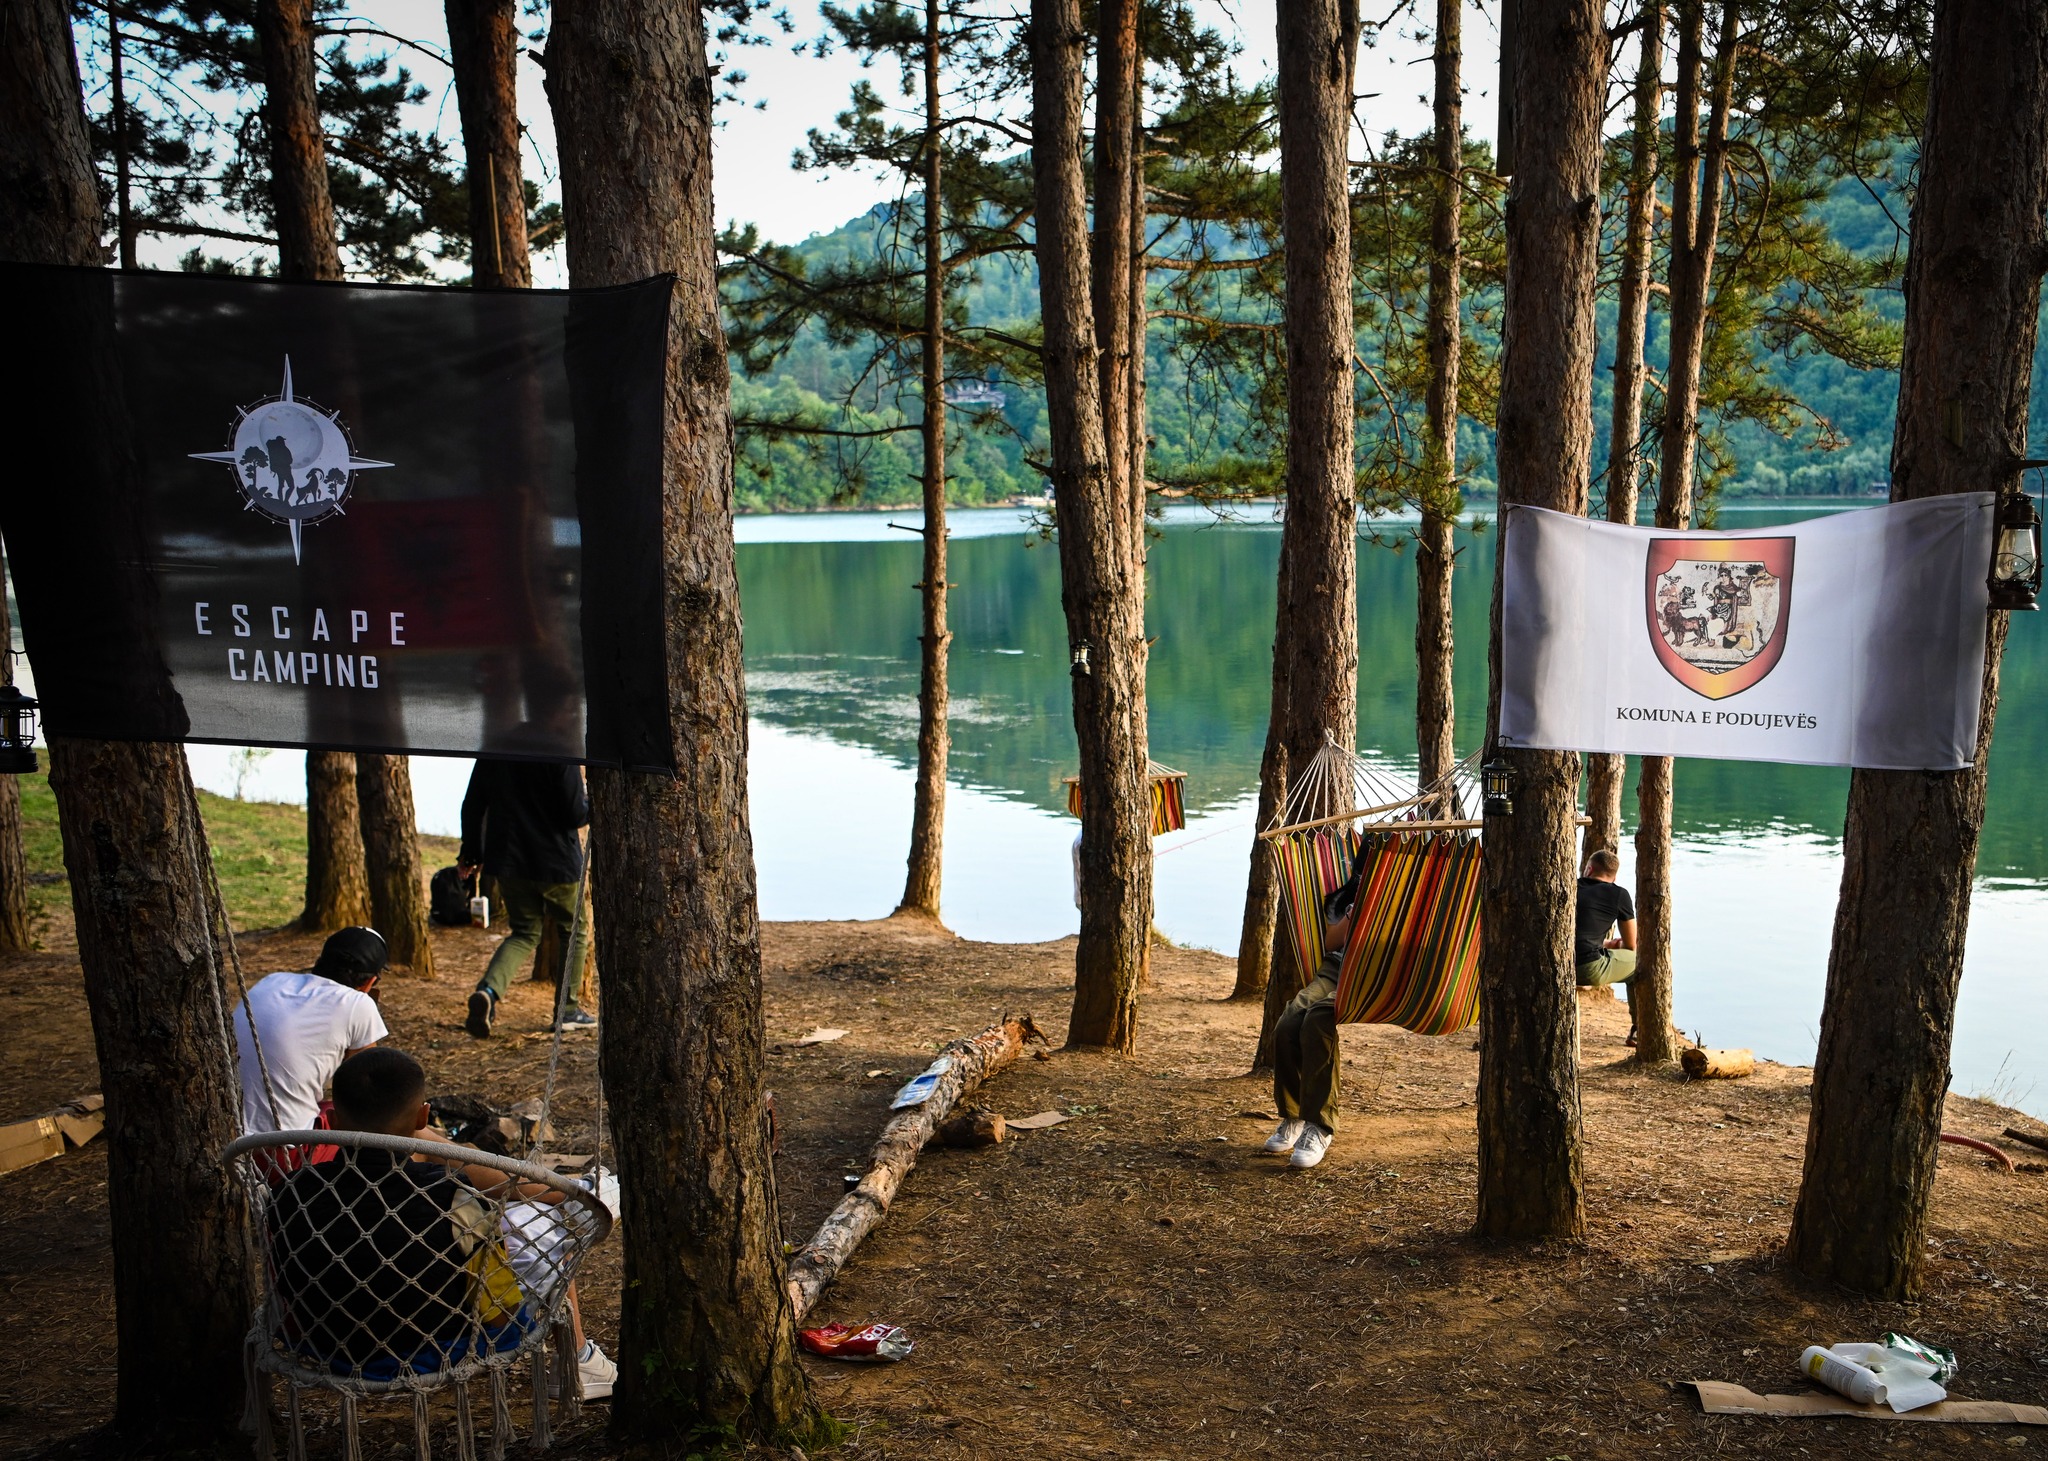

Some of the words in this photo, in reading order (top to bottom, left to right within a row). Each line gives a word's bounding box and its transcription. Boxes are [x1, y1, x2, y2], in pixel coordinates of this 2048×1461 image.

[195, 602, 406, 646] ESCAPE
[228, 648, 379, 689] CAMPING
[1616, 707, 1697, 723] KOMUNA
[1702, 711, 1712, 724] E
[1716, 712, 1817, 730] PODUJEVËS
